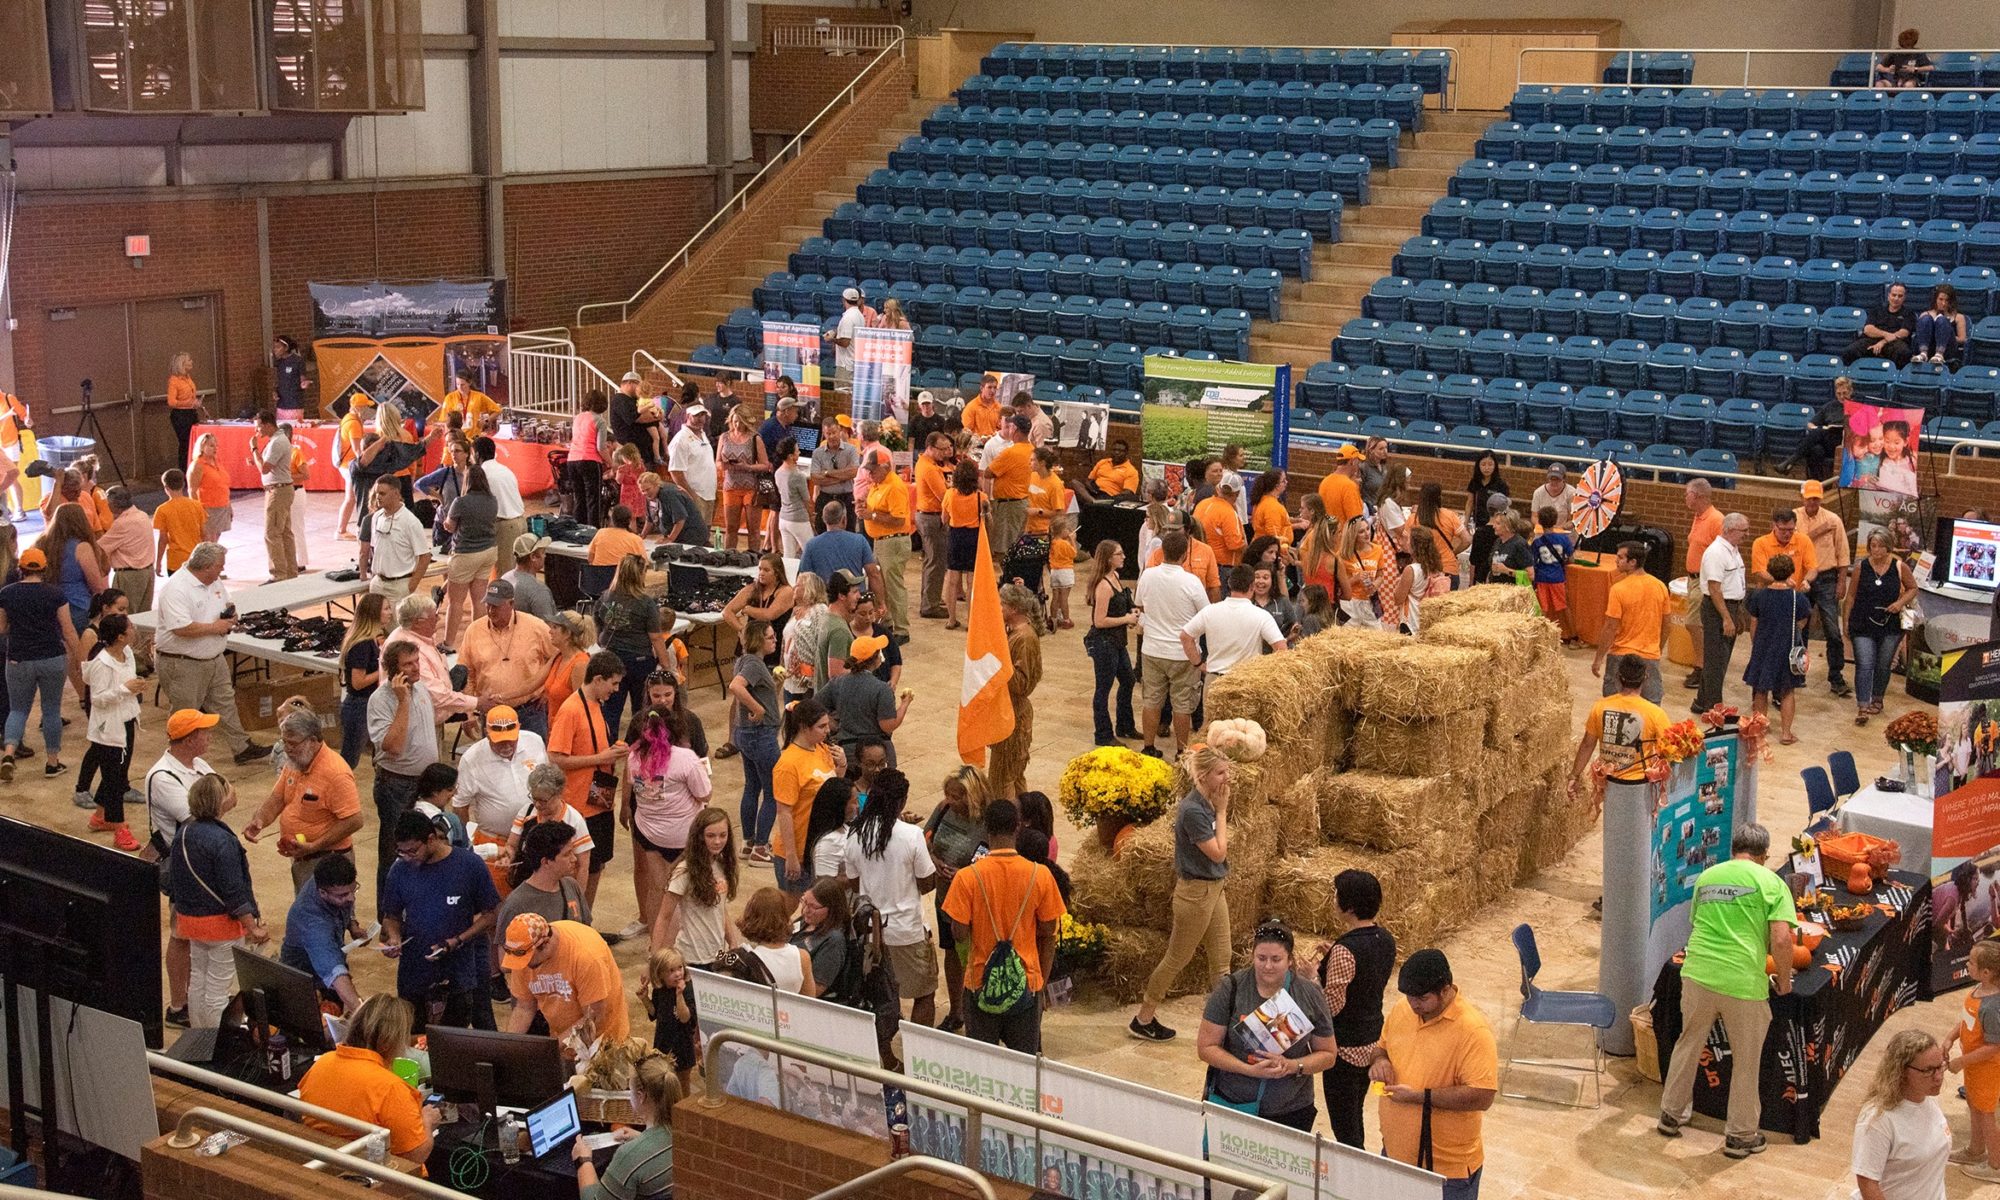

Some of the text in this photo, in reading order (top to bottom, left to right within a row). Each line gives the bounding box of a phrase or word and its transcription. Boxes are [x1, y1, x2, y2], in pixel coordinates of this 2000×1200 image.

[778, 336, 804, 345] PEOPLE
[890, 331, 911, 340] Library
[1898, 500, 1918, 513] AG
[1942, 799, 1967, 813] WHERE
[1968, 794, 1987, 806] YOUR
[1946, 810, 1969, 824] MAKES
[1717, 888, 1738, 896] ALEC
[1778, 1050, 1797, 1085] ALEC
